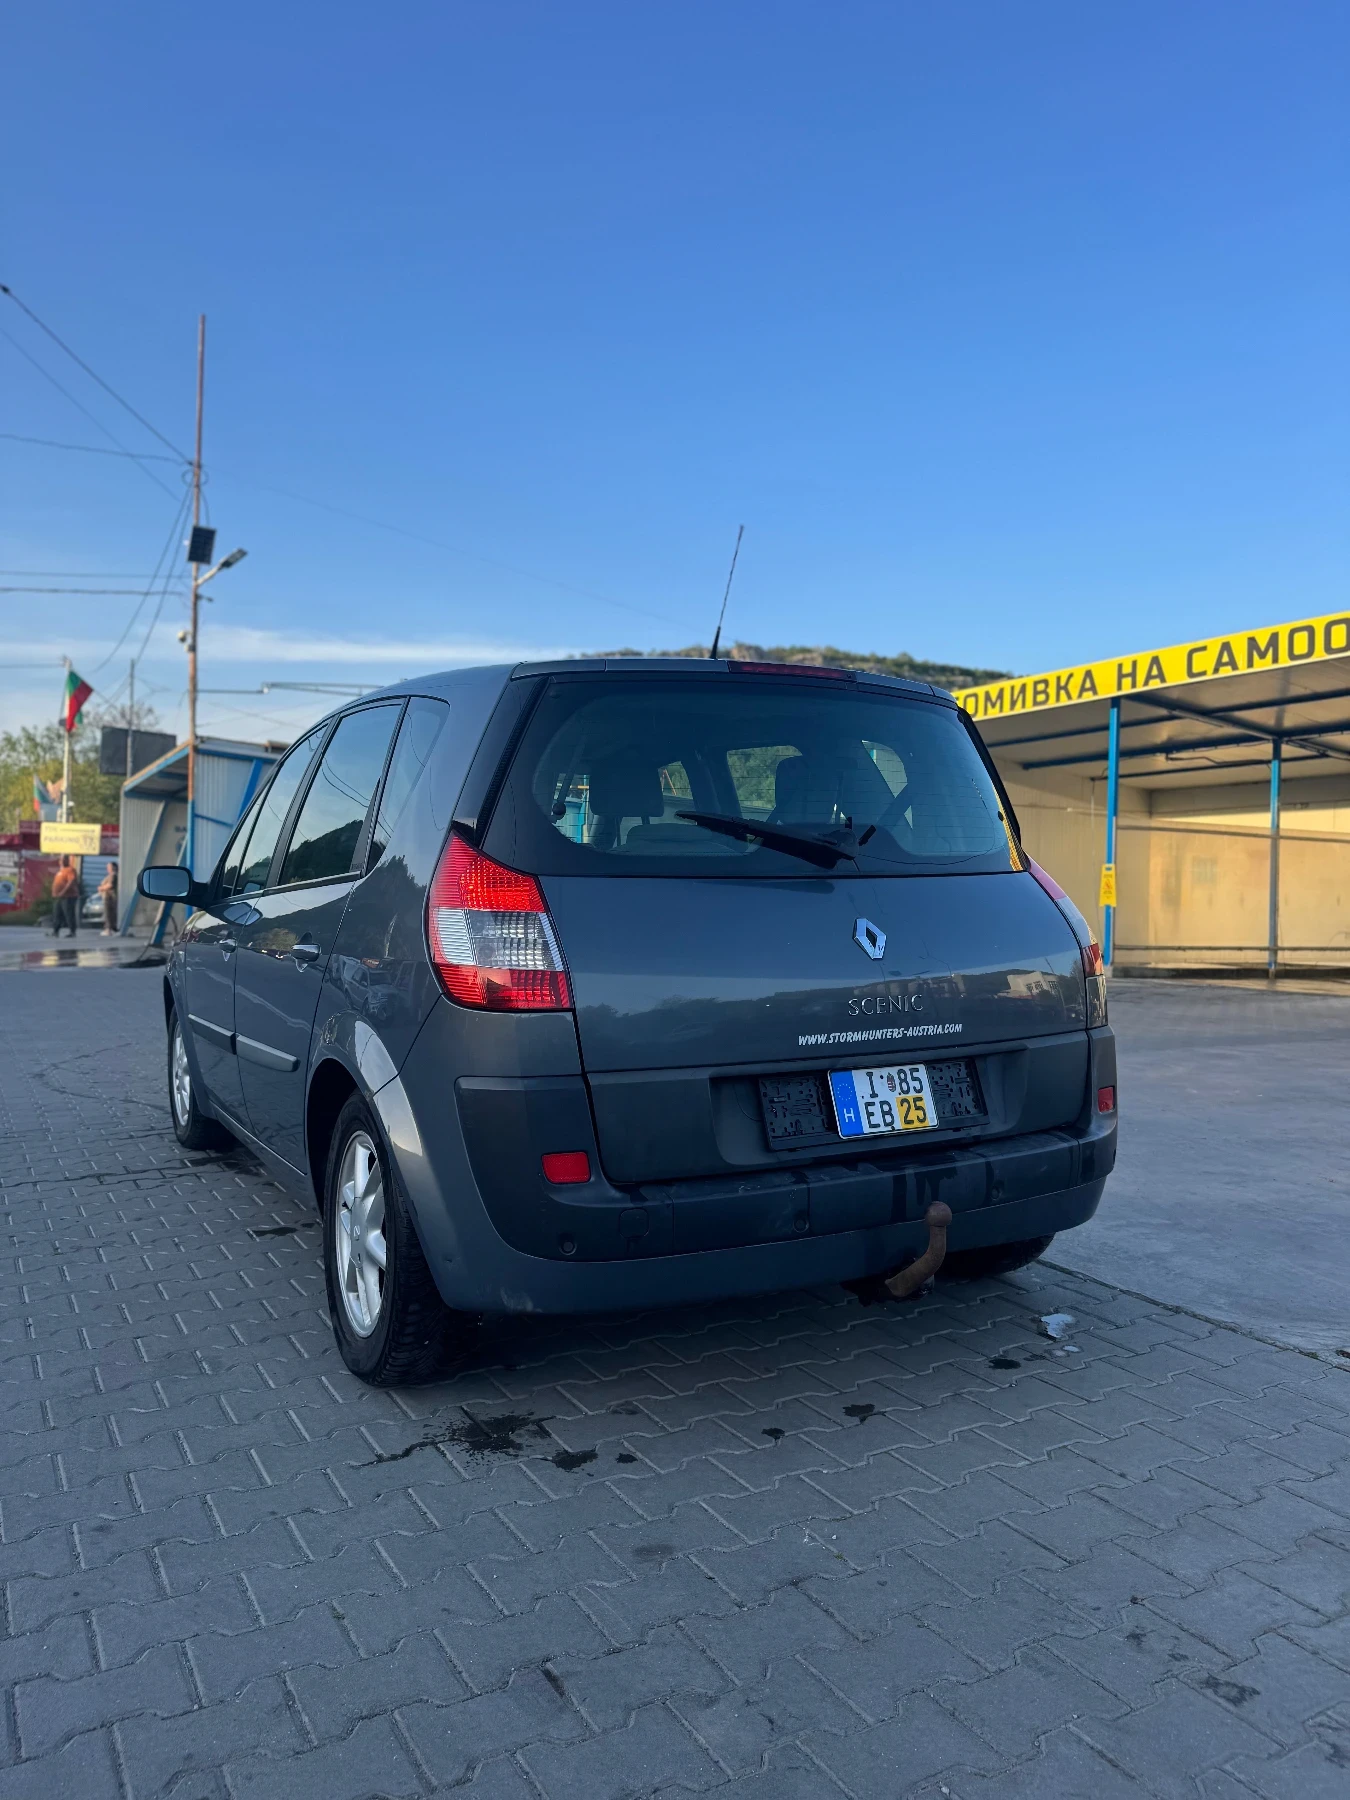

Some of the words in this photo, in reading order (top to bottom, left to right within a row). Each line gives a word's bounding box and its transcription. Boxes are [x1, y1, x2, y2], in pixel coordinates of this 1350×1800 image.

[956, 669, 1098, 717] ОМИВКА
[1116, 655, 1167, 692] НА
[1186, 617, 1350, 679] САМОО
[848, 994, 924, 1016] SCENIC
[798, 1023, 963, 1046] WWW.STORMHUNTERS-AUSTRIA.COM
[866, 1071, 879, 1098] I
[897, 1067, 924, 1095] 85
[843, 1107, 856, 1123] H
[864, 1100, 895, 1129] EB
[900, 1096, 927, 1125] 25
